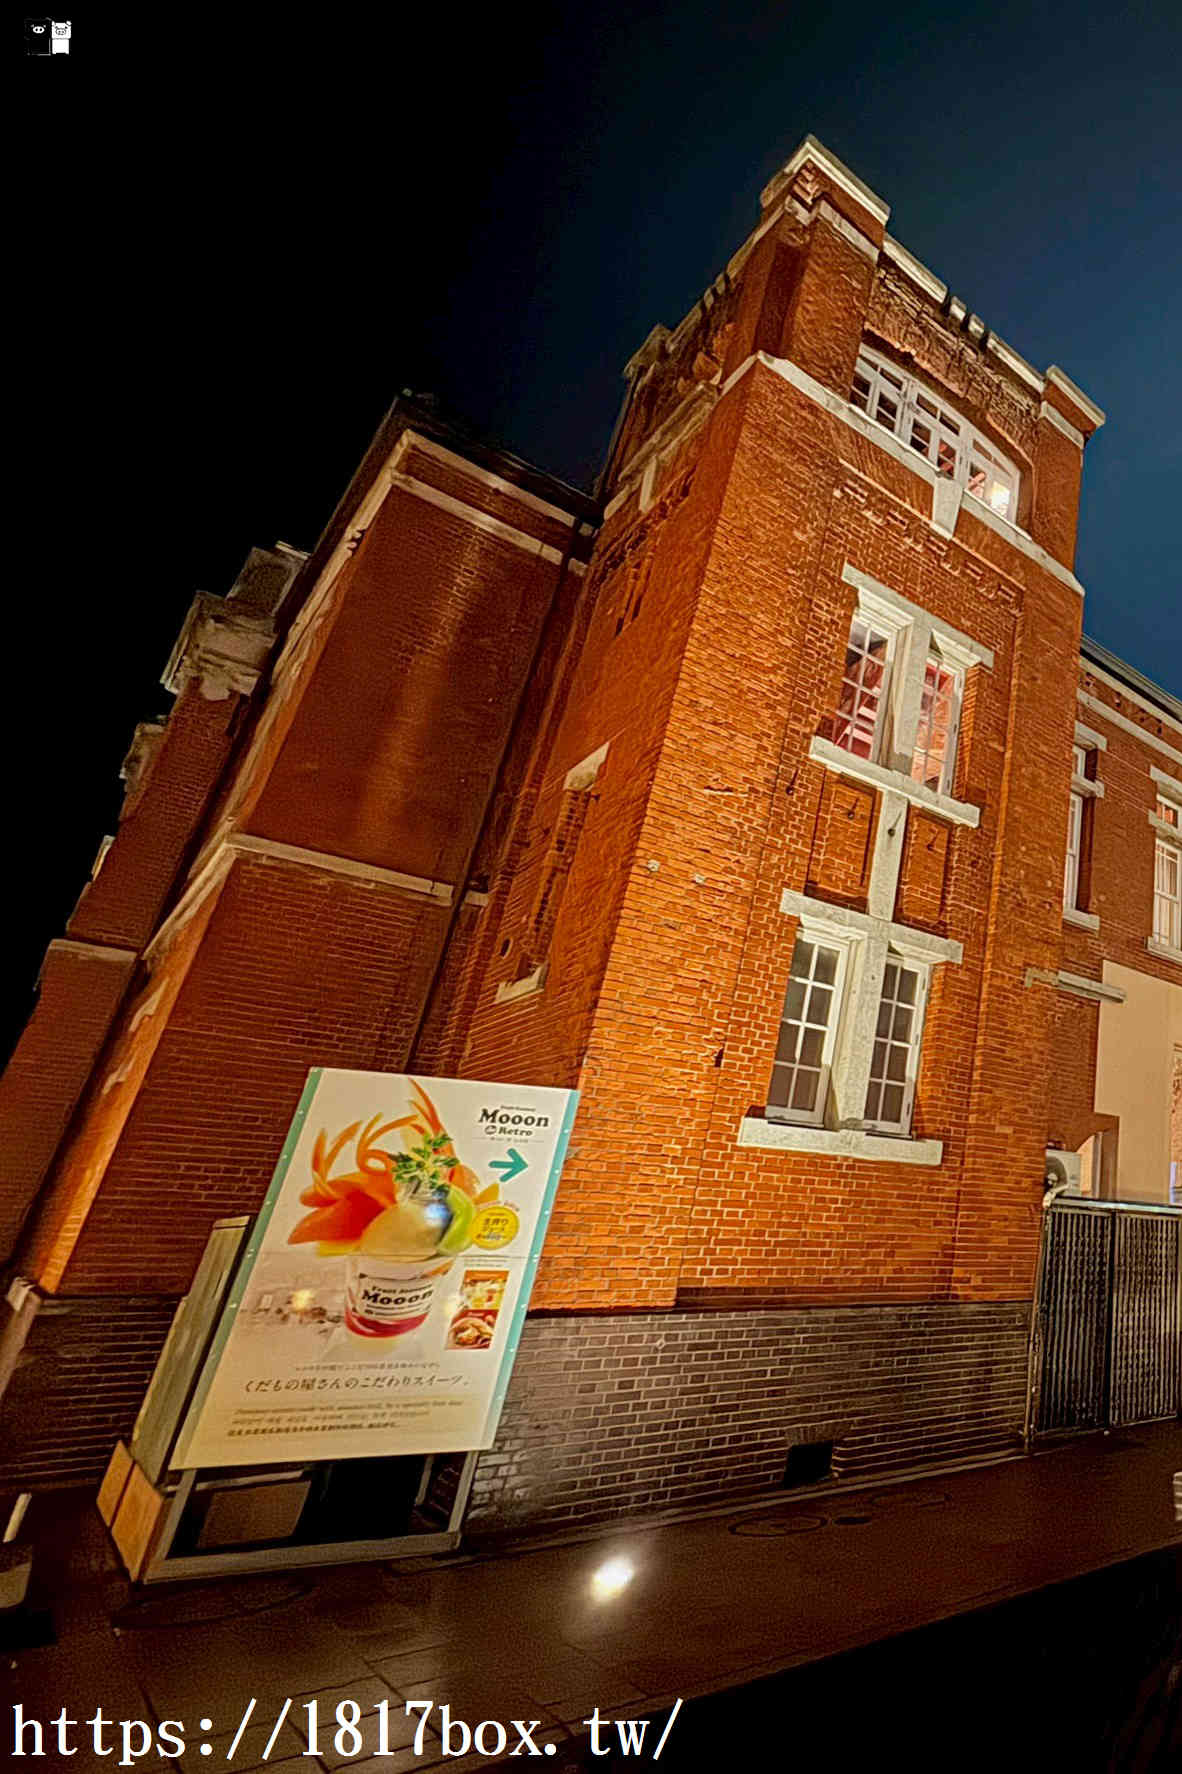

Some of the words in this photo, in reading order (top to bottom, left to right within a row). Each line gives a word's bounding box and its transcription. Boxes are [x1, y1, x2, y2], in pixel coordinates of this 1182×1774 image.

[478, 1108, 549, 1127] Mooon
[498, 1126, 533, 1136] Retro
[361, 1289, 433, 1305] Mooon
